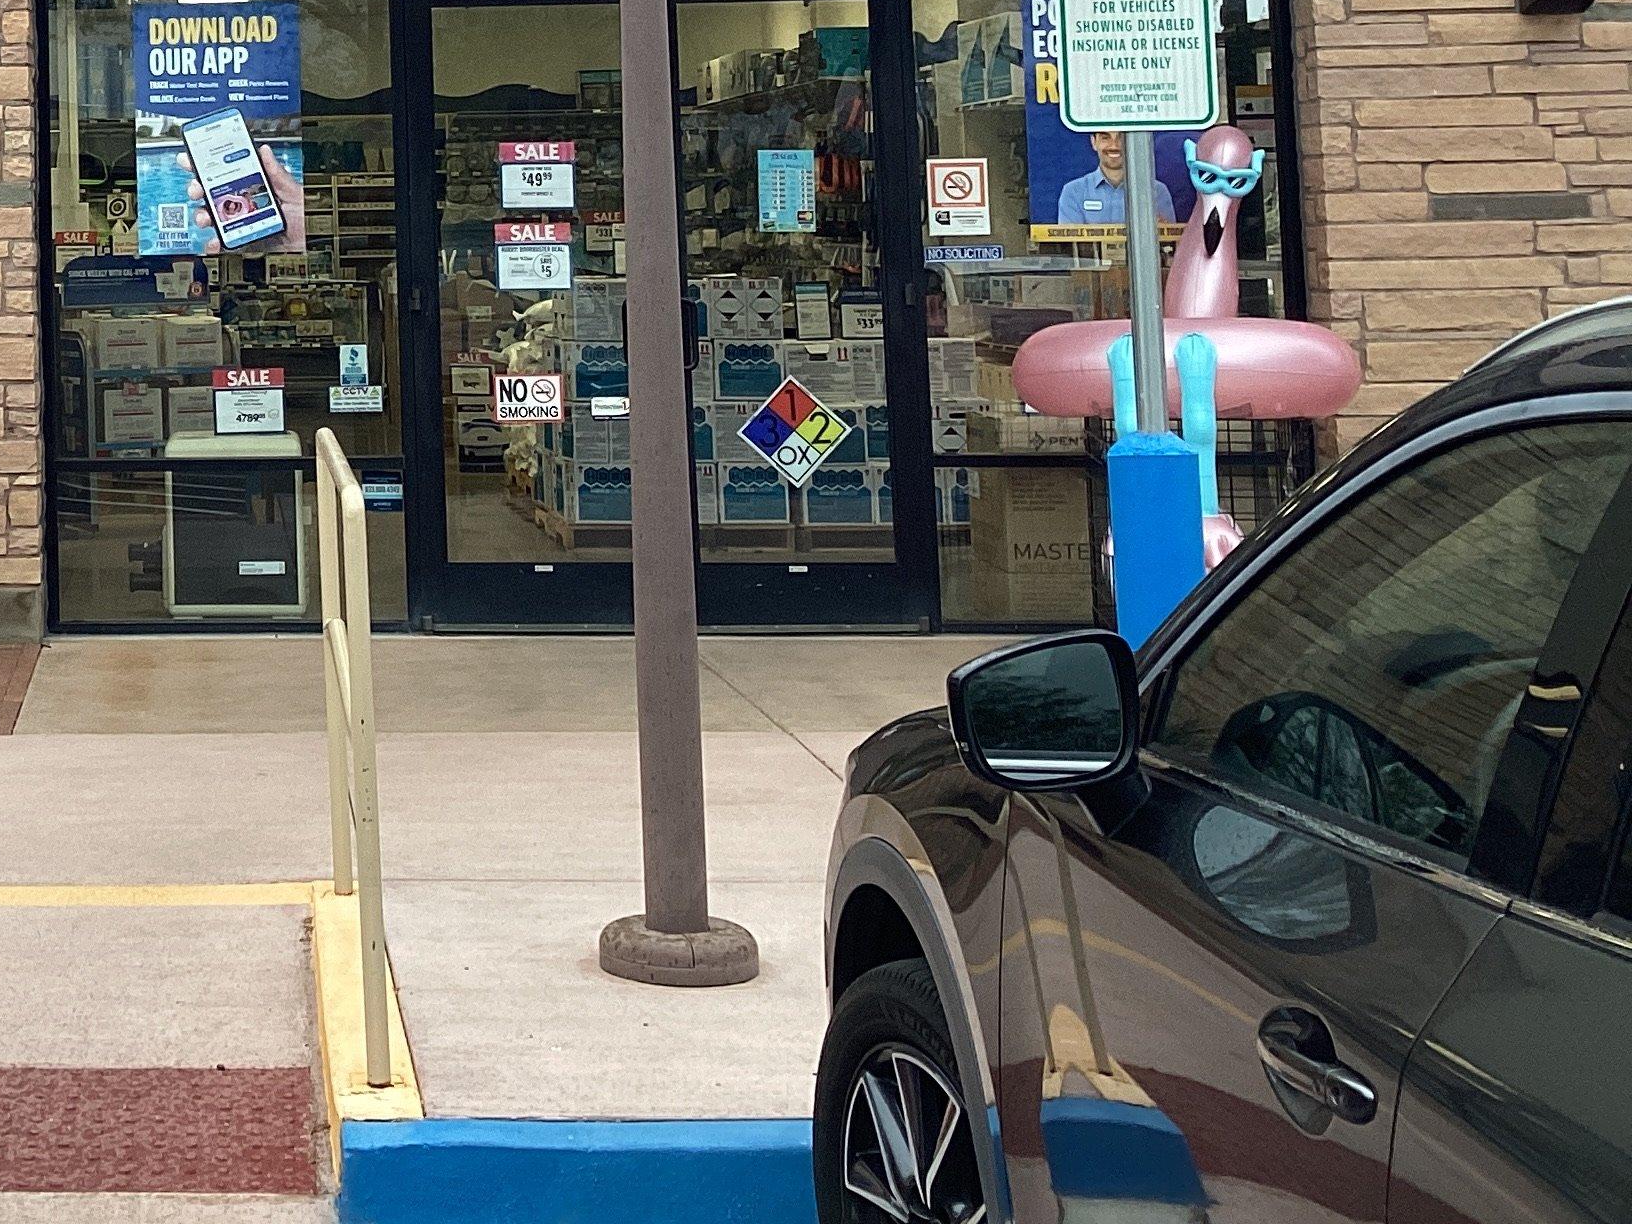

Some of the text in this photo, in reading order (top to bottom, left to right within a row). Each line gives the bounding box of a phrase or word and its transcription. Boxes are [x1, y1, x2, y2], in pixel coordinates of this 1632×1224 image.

[1093, 0, 1175, 14] FOR VEHICLES
[148, 15, 278, 45] DOWNLOAD
[1076, 18, 1194, 33] SHOWING DISABLED
[1072, 37, 1200, 52] INSIGNIA OR LICENSE
[148, 46, 249, 76] OUR APP
[1102, 56, 1172, 71] PLATE ONLY
[513, 143, 561, 161] SALE
[593, 211, 621, 223] SALE
[63, 232, 90, 244] SALE
[509, 224, 556, 242] SALE
[927, 247, 1000, 260] NO SOLICITING
[458, 354, 482, 363] SALE
[226, 369, 271, 387] SALE
[342, 387, 369, 395] CCTV
[499, 378, 528, 403] NO
[499, 405, 559, 419] SMOKING
[784, 388, 797, 422] 1
[759, 414, 780, 448] 3
[808, 411, 832, 445] 2
[776, 445, 813, 465] OX
